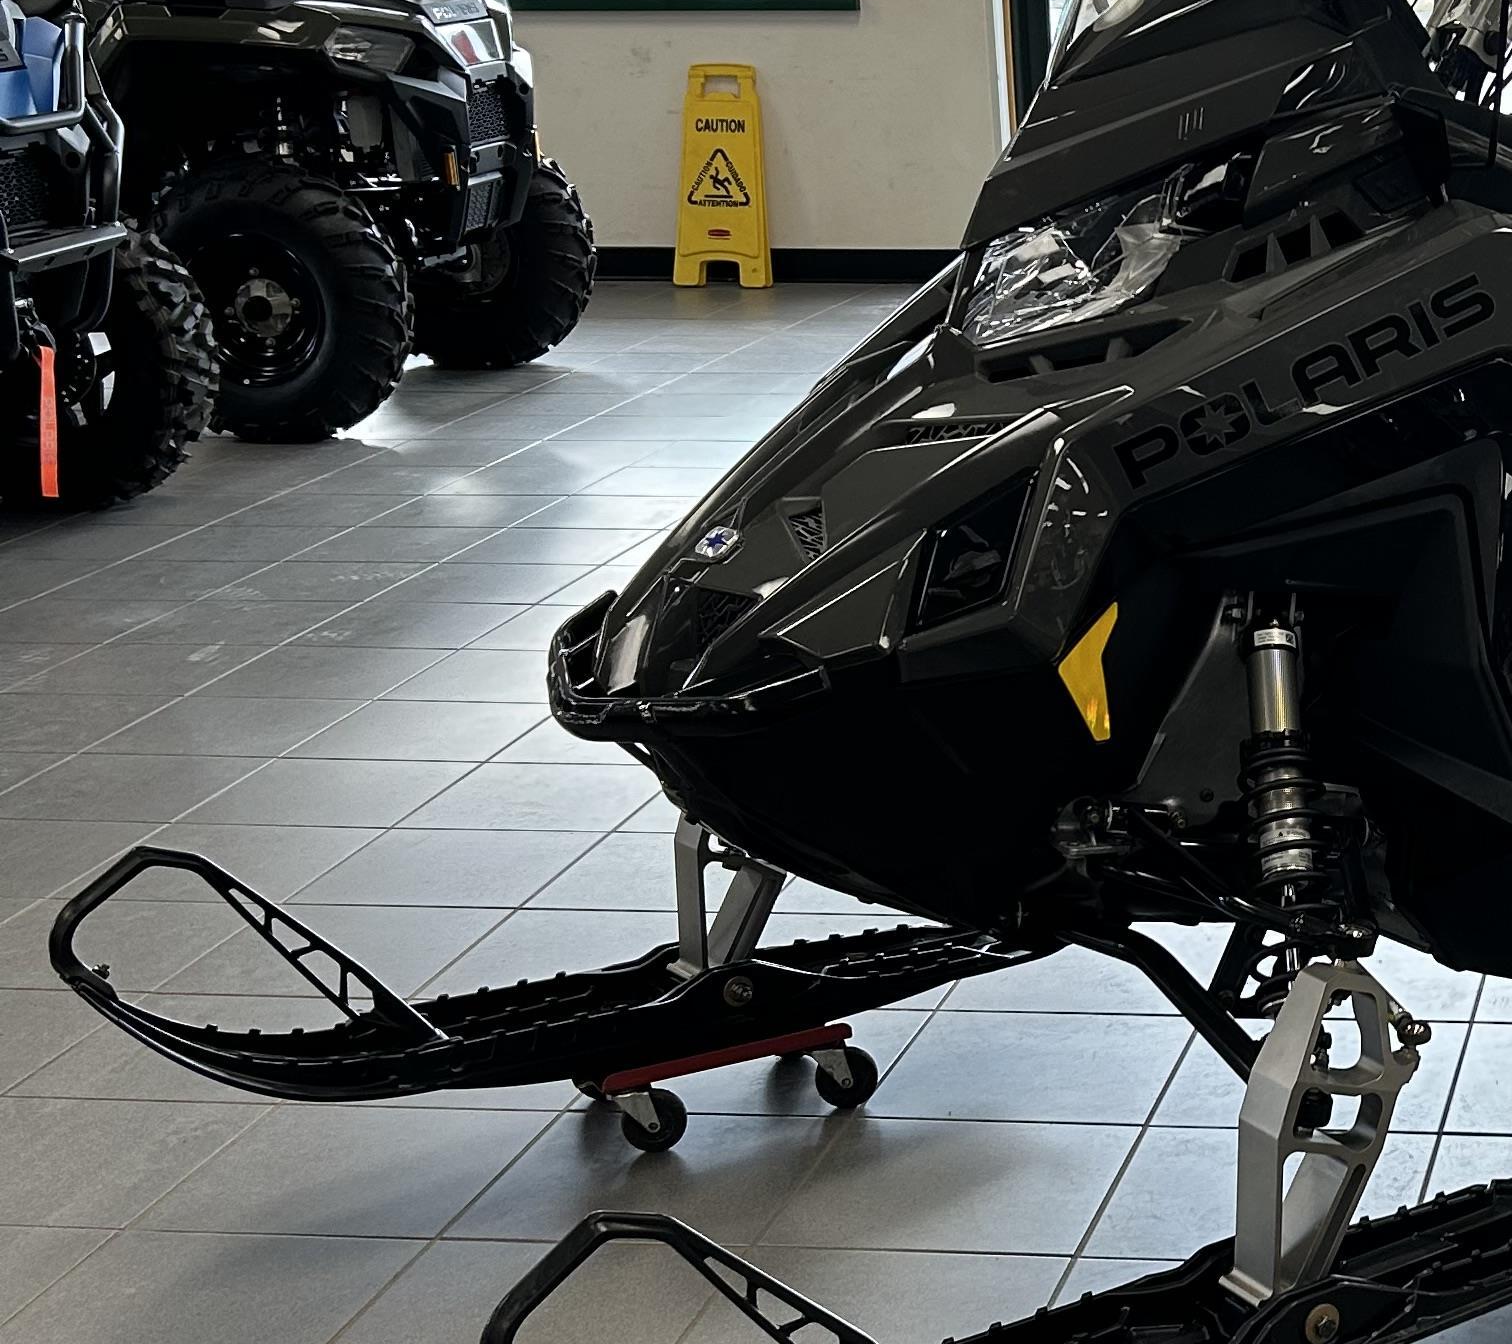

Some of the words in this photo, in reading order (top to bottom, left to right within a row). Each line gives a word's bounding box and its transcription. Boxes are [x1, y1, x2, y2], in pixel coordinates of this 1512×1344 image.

[695, 118, 745, 133] CAUTION
[691, 160, 713, 191] CAUTION
[725, 160, 747, 193] CUIDADO
[697, 199, 739, 208] ATTENTION
[1112, 271, 1498, 491] POLARIS
